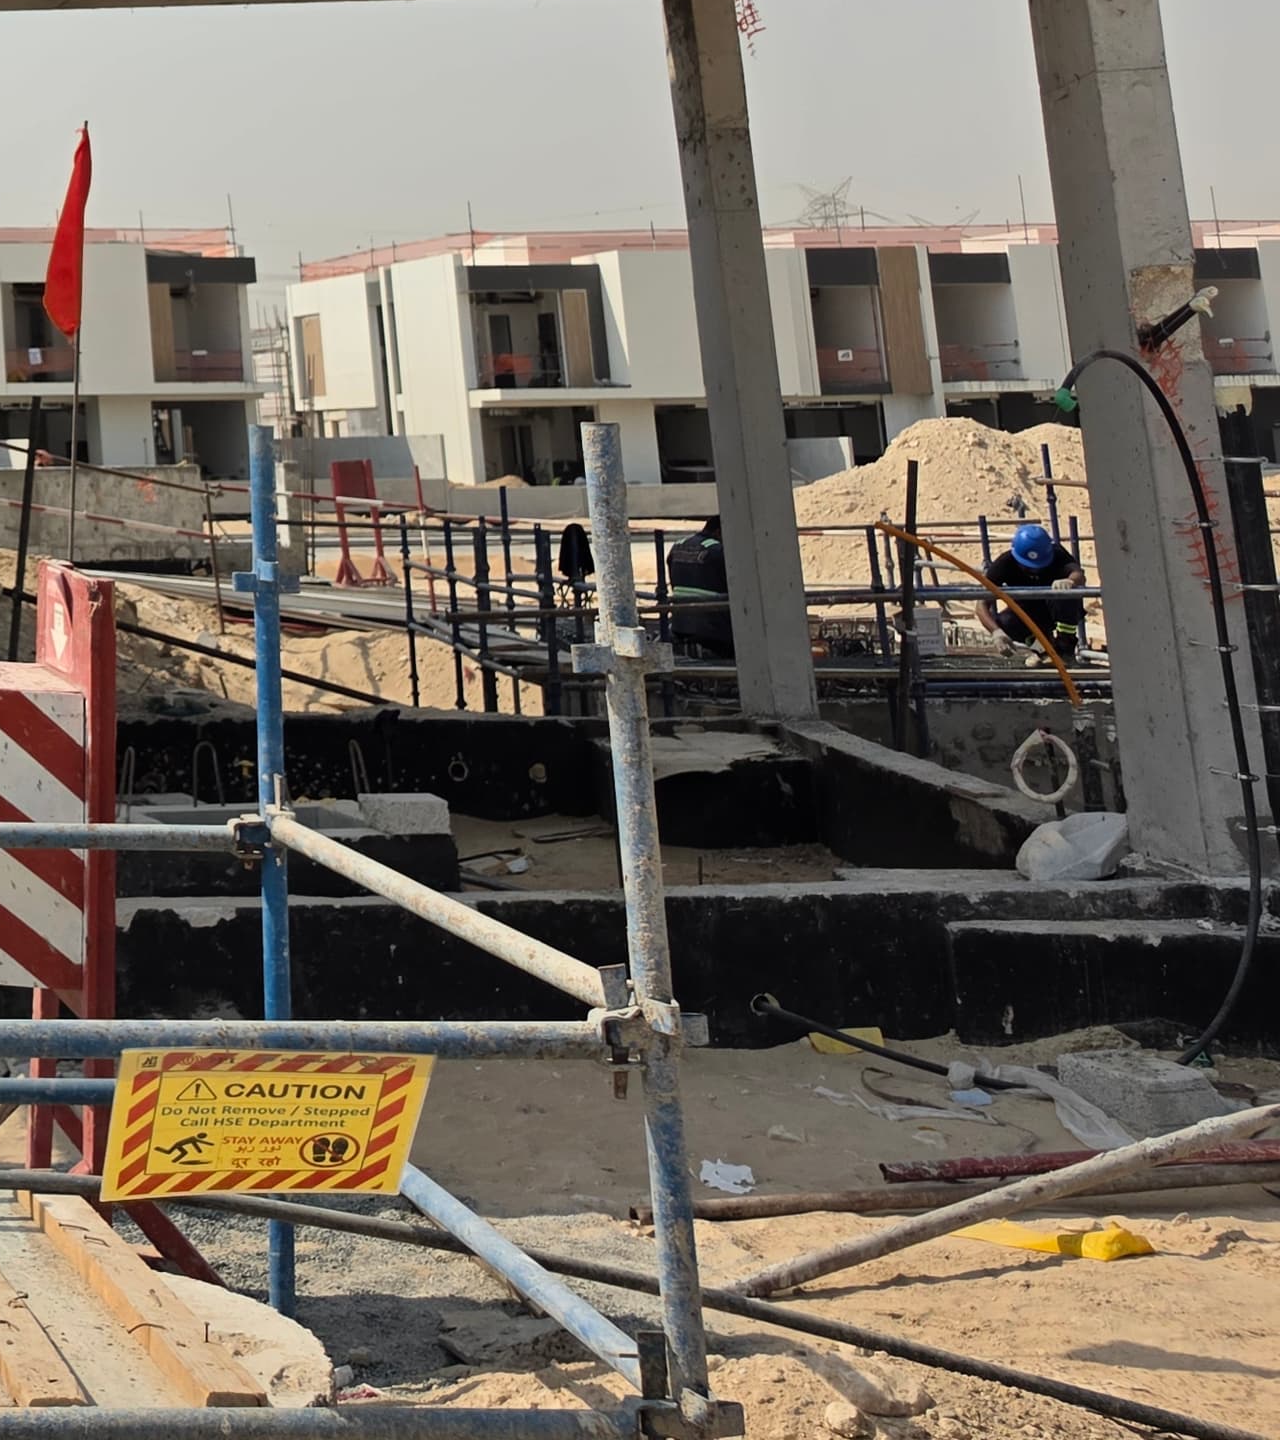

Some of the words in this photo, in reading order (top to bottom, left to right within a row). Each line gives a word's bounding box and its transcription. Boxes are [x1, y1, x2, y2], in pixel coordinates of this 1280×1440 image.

[224, 1083, 366, 1100] CAUTION
[161, 1106, 183, 1116] Do
[187, 1105, 216, 1115] Not
[222, 1105, 286, 1116] Remove
[290, 1105, 300, 1116] /
[303, 1106, 370, 1118] Stepped
[180, 1117, 208, 1127] Call
[213, 1117, 244, 1127] HSE
[248, 1117, 346, 1129] Department
[223, 1136, 256, 1145] STAY
[259, 1136, 303, 1145] AWAY
[232, 1157, 251, 1169] दूर
[258, 1156, 282, 1167] रहो
